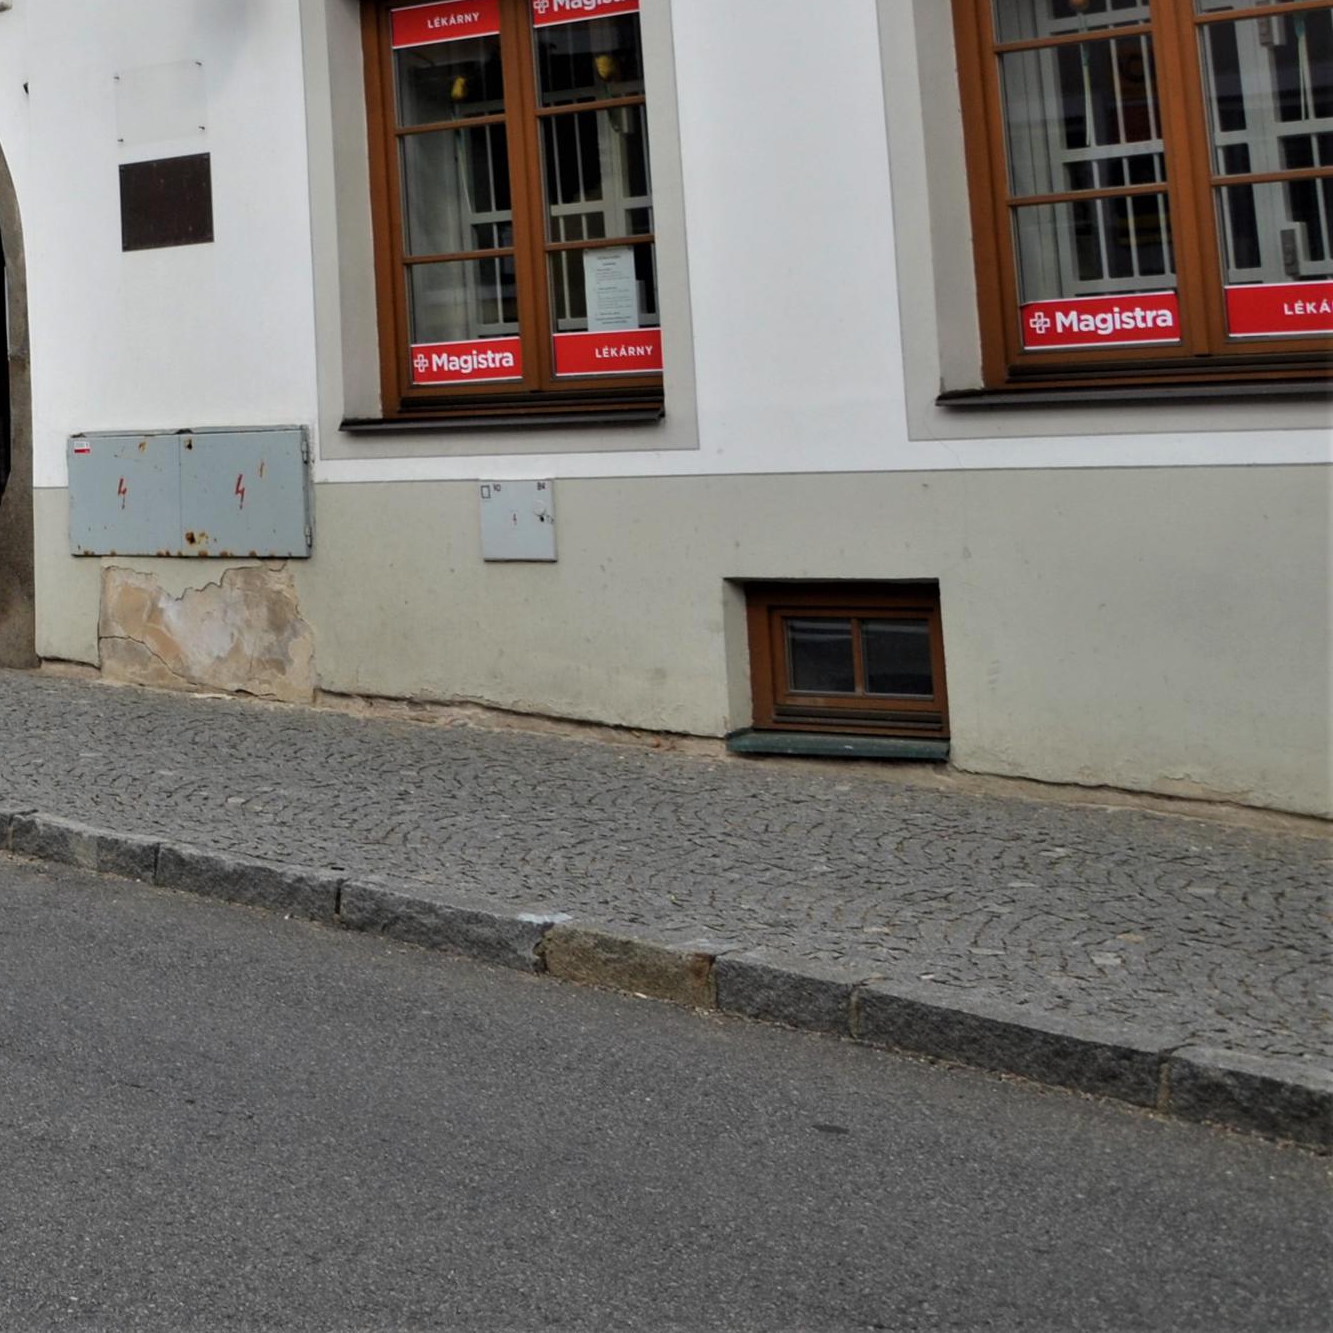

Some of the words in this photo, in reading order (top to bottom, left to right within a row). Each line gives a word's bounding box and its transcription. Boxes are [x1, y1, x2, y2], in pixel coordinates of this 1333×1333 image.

[427, 11, 480, 29] LÉKÁRNY
[1283, 298, 1333, 316] LÉKÁ
[1055, 306, 1173, 335] Magistra
[595, 344, 653, 359] LÉKÁRNY
[432, 349, 514, 374] Magistra
